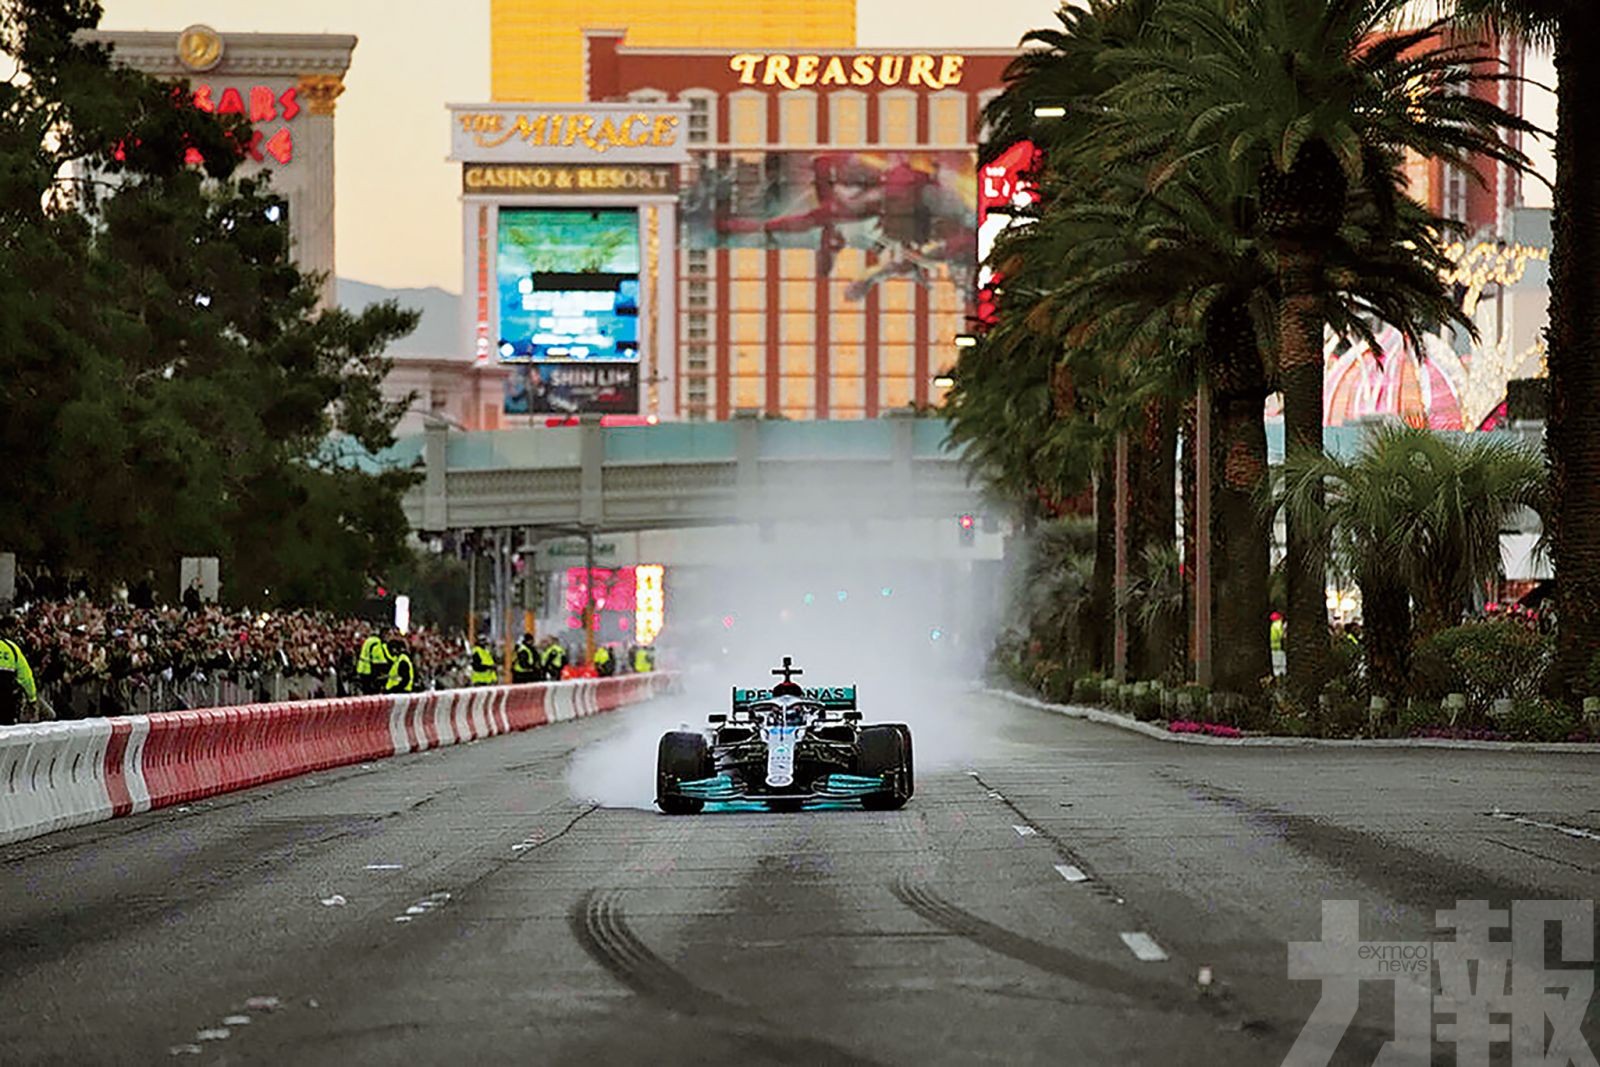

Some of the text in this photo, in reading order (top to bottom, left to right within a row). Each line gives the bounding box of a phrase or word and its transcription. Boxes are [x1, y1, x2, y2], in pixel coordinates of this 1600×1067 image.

[730, 54, 965, 90] TREASURE
[459, 112, 679, 152] THE MIRAGE
[465, 167, 671, 188] CASINO & RESORT
[745, 688, 844, 700] PENAS
